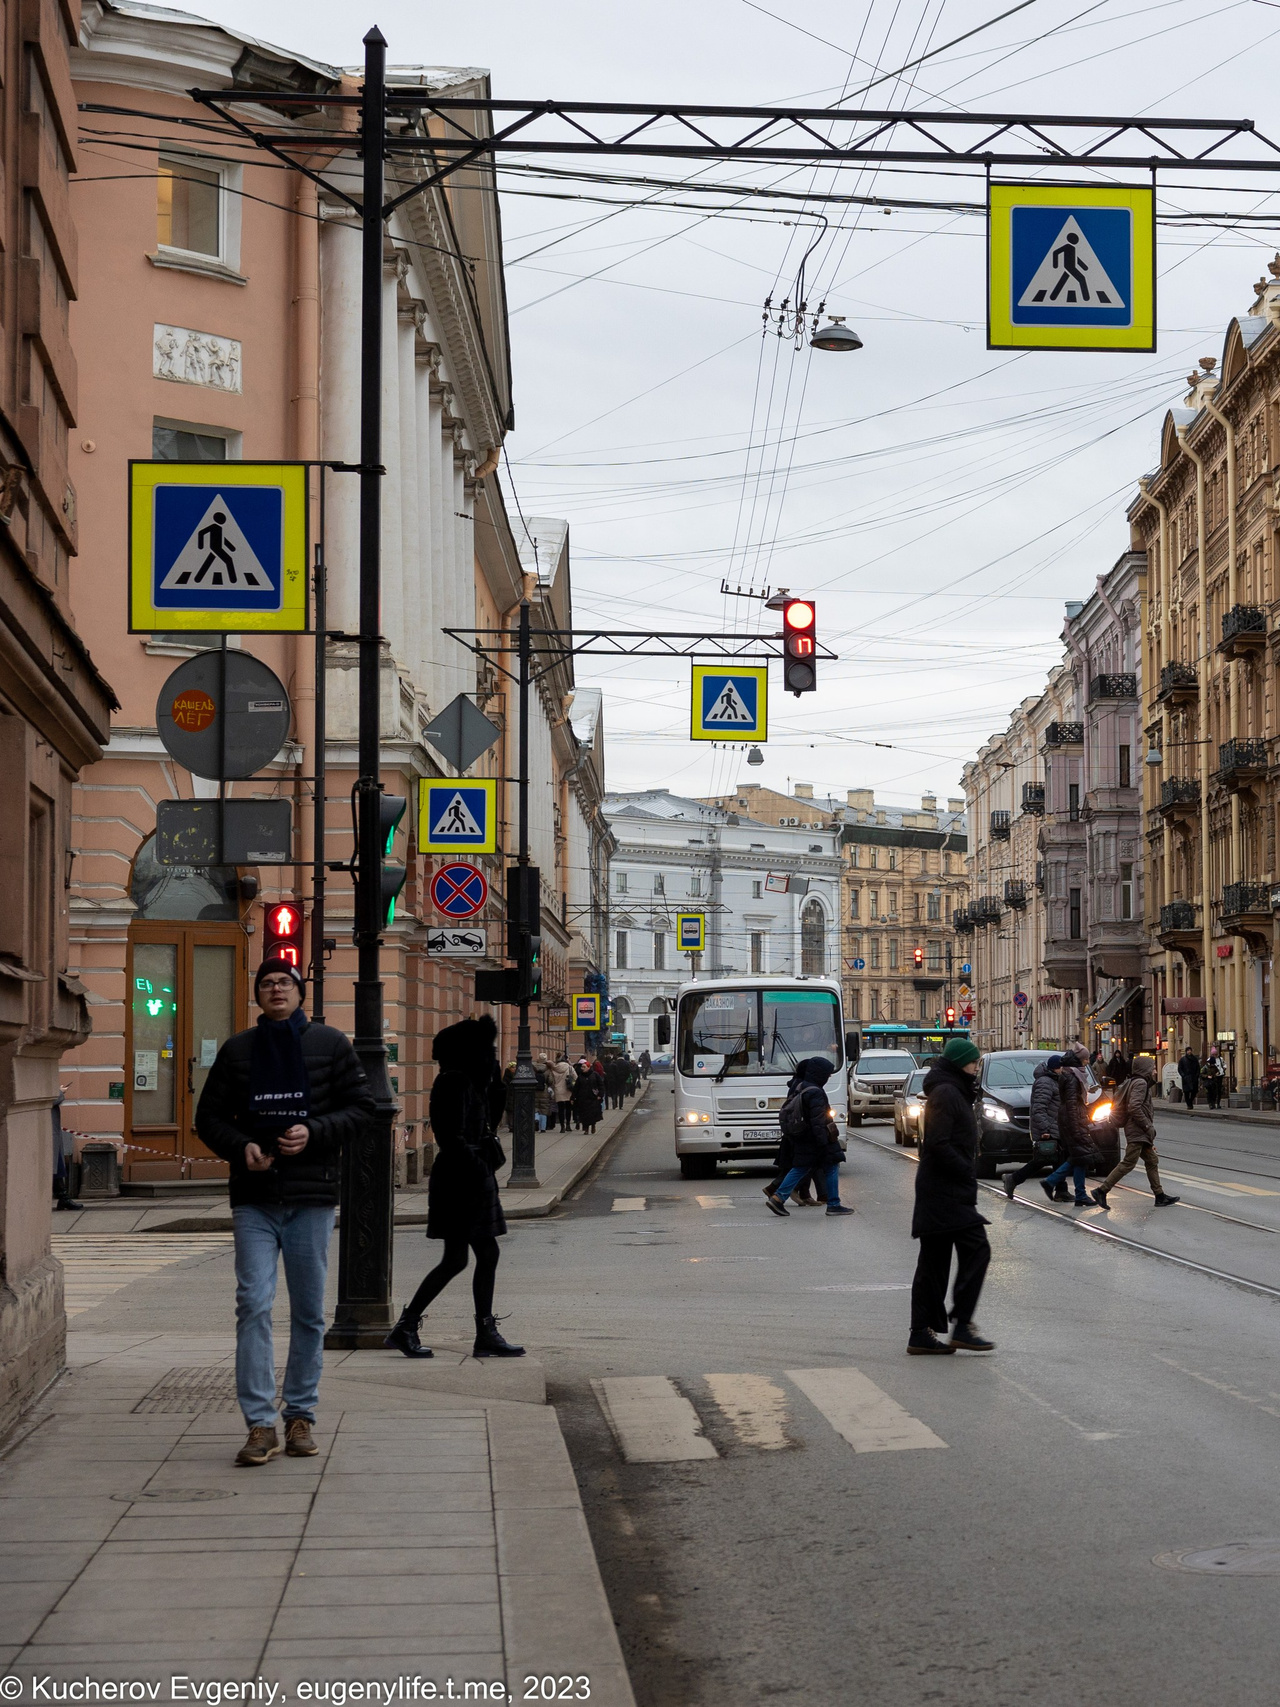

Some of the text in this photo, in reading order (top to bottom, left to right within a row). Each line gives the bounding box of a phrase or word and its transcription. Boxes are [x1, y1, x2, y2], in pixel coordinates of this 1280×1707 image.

[797, 638, 812, 654] 17
[174, 699, 214, 710] КАШЕЛЬ
[254, 1092, 304, 1101] UMBRO
